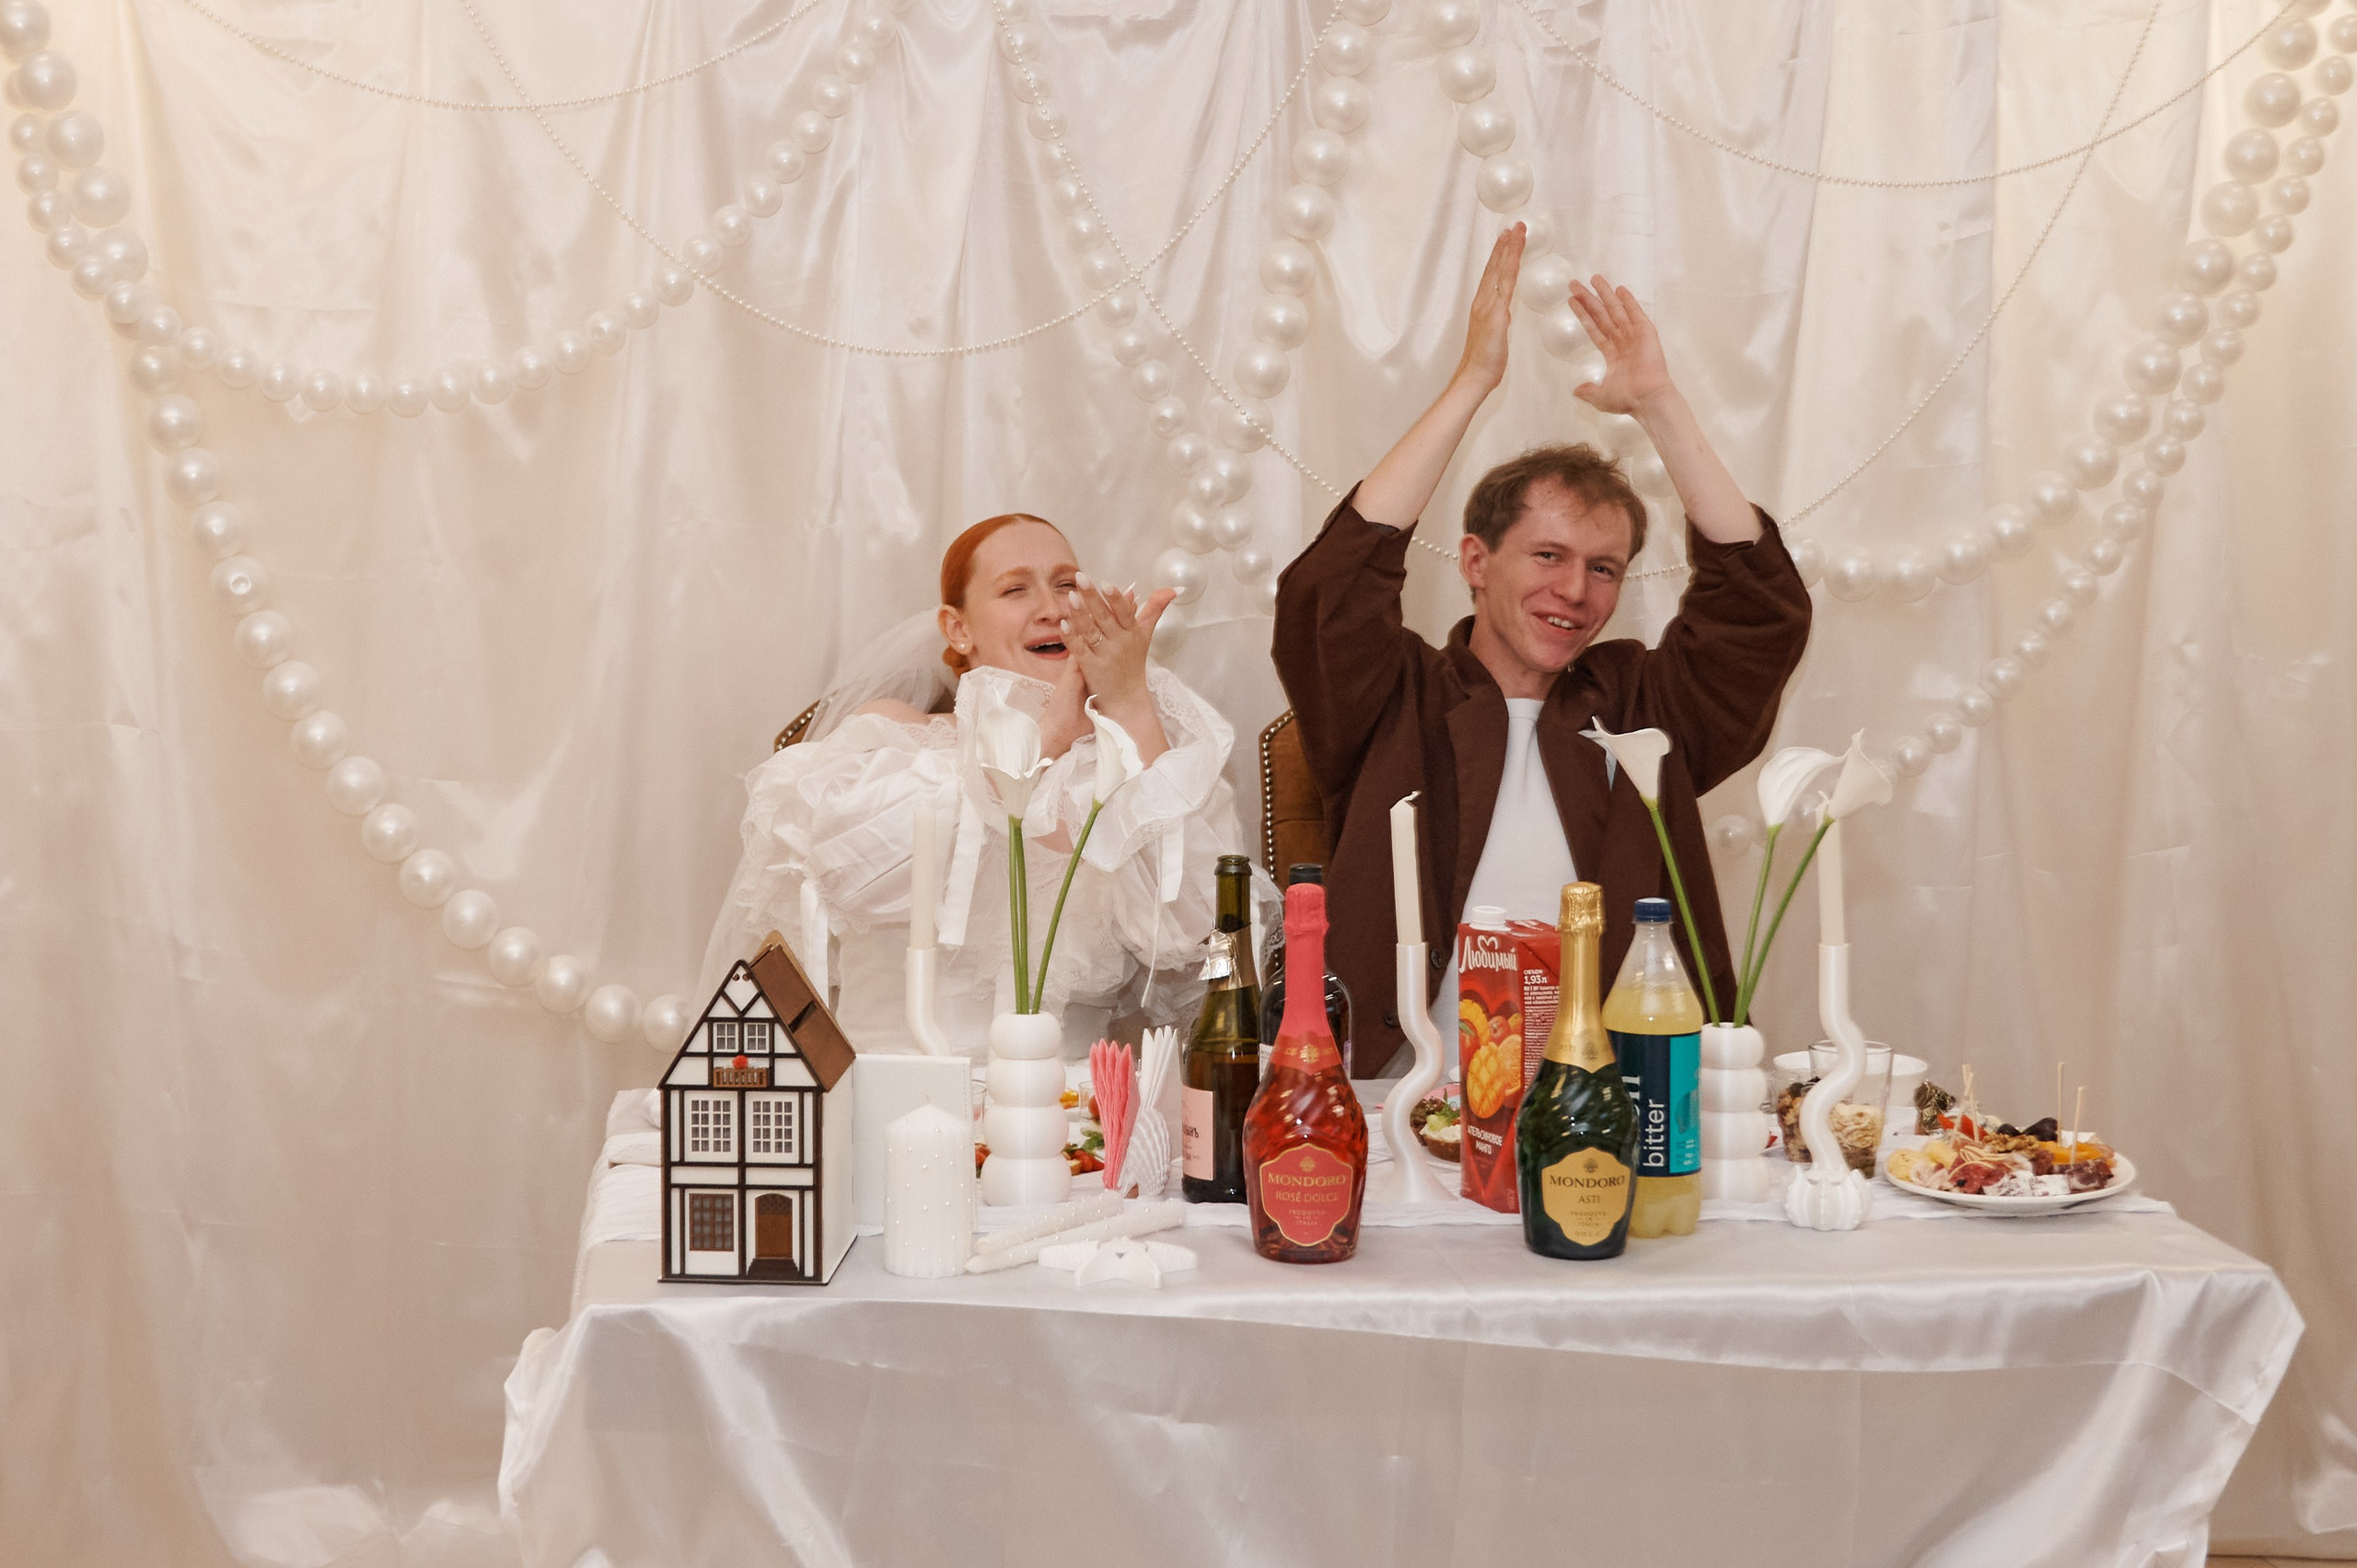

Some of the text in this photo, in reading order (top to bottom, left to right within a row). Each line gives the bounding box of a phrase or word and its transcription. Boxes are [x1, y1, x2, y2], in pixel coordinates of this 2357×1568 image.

[1458, 935, 1517, 973] Любимый
[1468, 1124, 1503, 1146] АПЕЛЬСИНОВОЕ
[1643, 1098, 1665, 1167] bitter
[1475, 1140, 1492, 1155] МАНГО
[1268, 1173, 1346, 1187] MONDORO
[1550, 1175, 1625, 1189] MONDORO
[1275, 1191, 1339, 1202] ROSÉ DOLCE
[1578, 1195, 1600, 1203] ASTI
